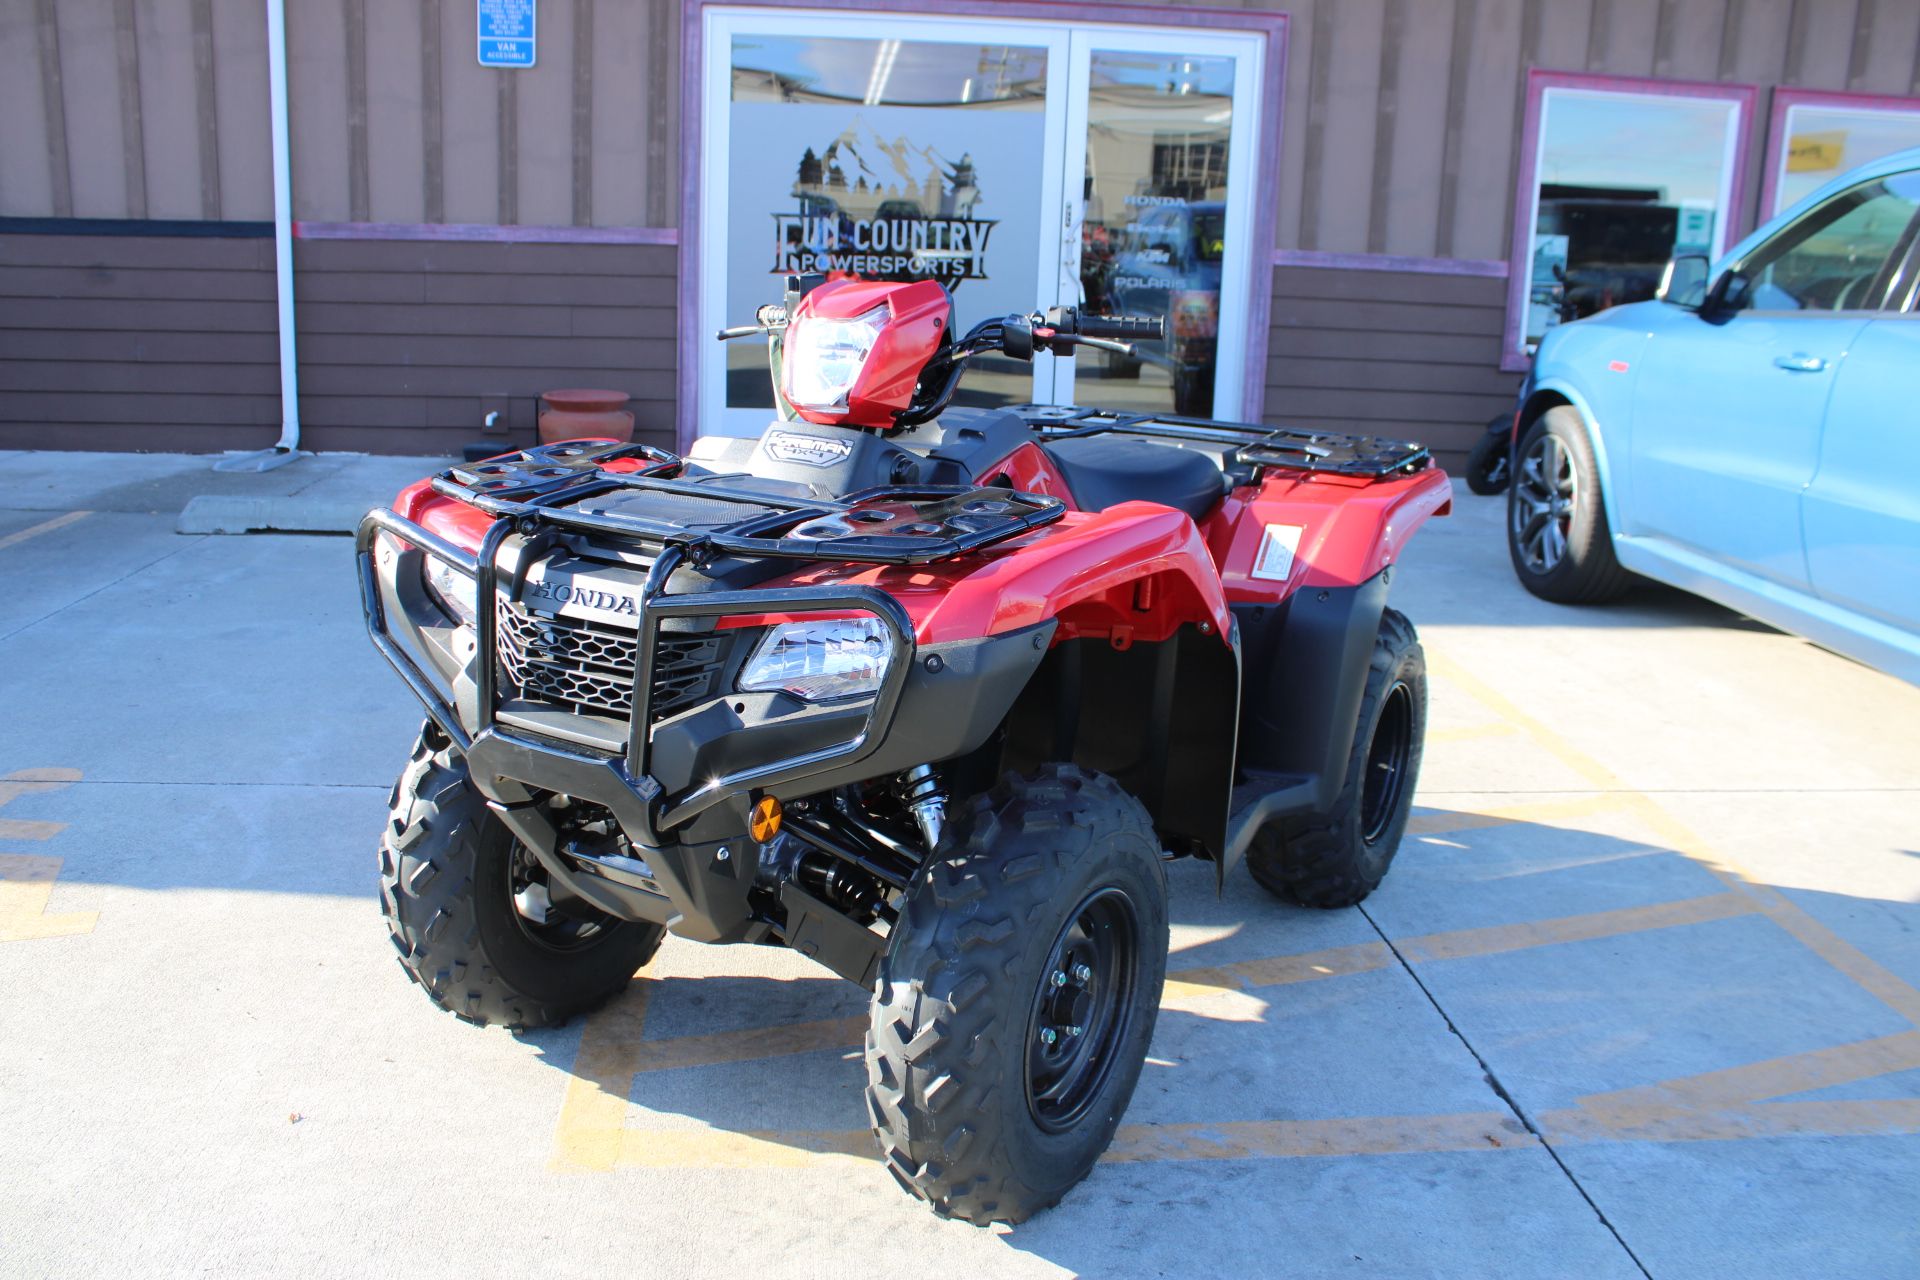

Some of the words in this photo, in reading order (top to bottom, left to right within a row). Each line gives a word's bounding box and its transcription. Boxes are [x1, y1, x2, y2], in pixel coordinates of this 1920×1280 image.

[496, 42, 517, 51] VAN
[486, 52, 526, 60] ACCESSIBLE
[1124, 196, 1187, 208] HONDA
[778, 216, 841, 273] FUN
[854, 218, 990, 277] COUNTRY
[801, 254, 966, 276] POWERSPORTS
[1114, 277, 1187, 290] POLARIS
[530, 580, 640, 617] HONDA
